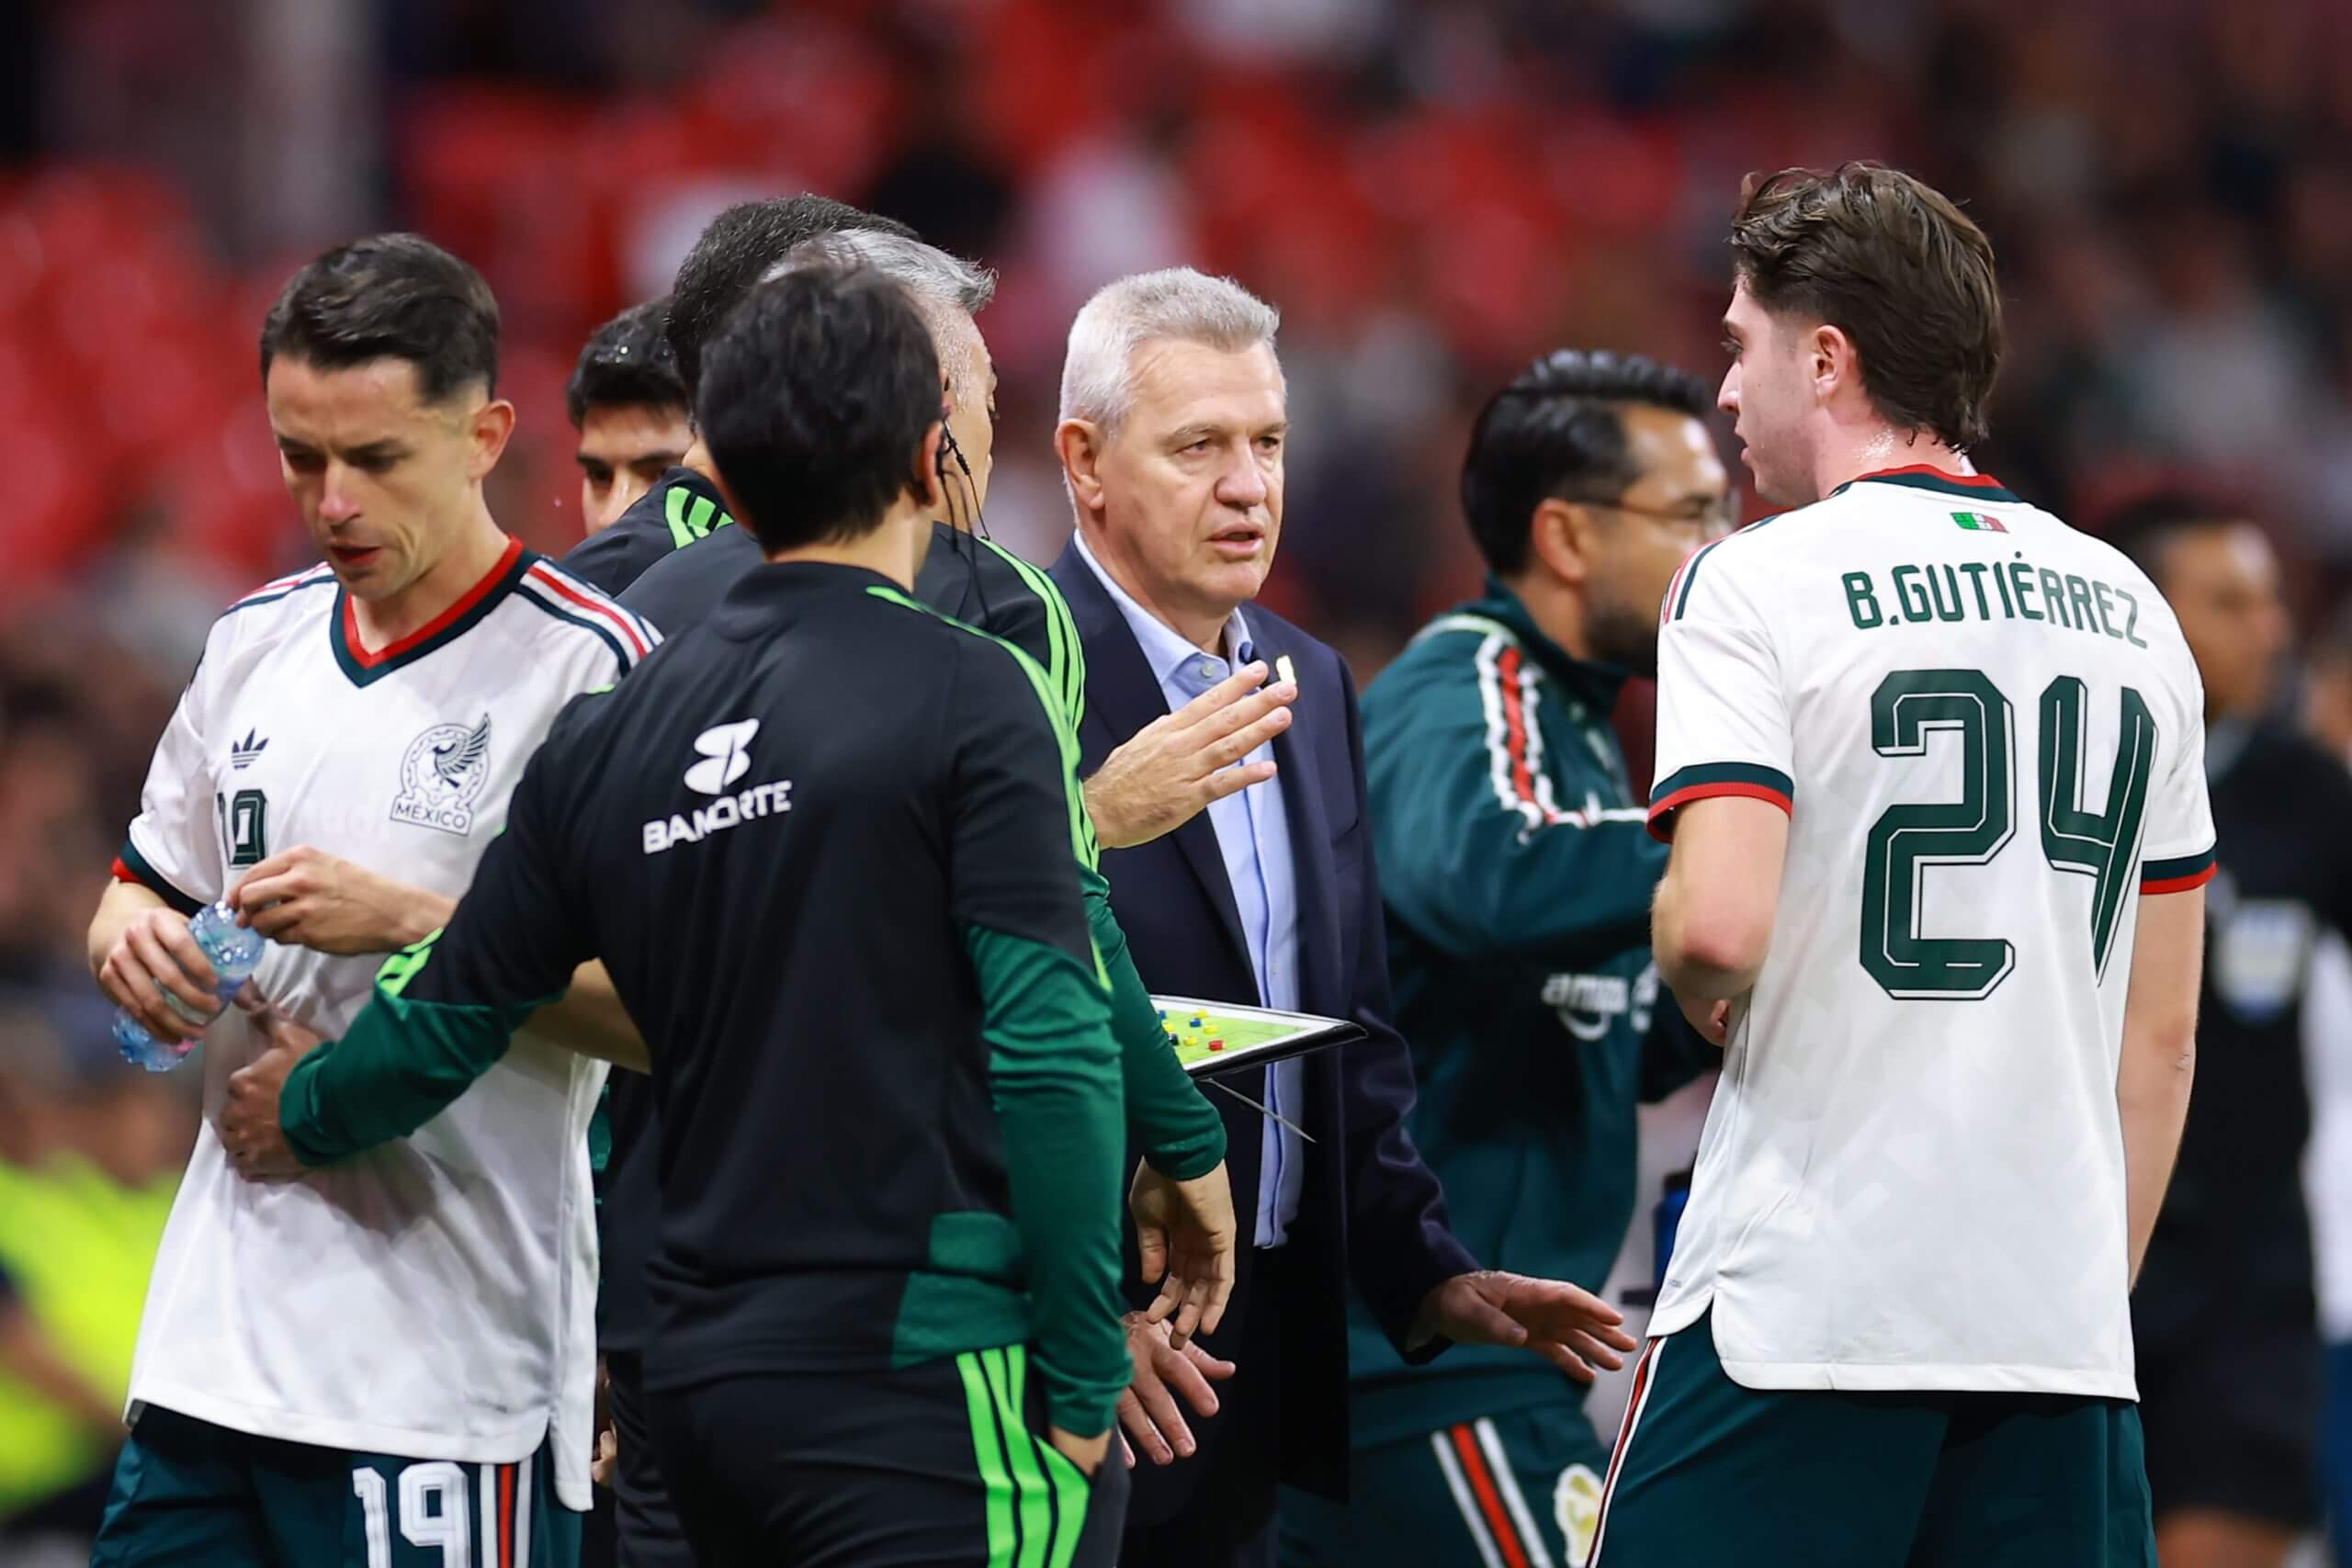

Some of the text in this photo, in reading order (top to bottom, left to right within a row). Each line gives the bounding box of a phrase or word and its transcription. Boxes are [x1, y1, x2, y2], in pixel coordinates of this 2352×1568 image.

[1841, 550, 2148, 649] B.GUTIÉRREZ
[1860, 669, 2159, 1000] 24
[353, 1461, 471, 1568] 19
